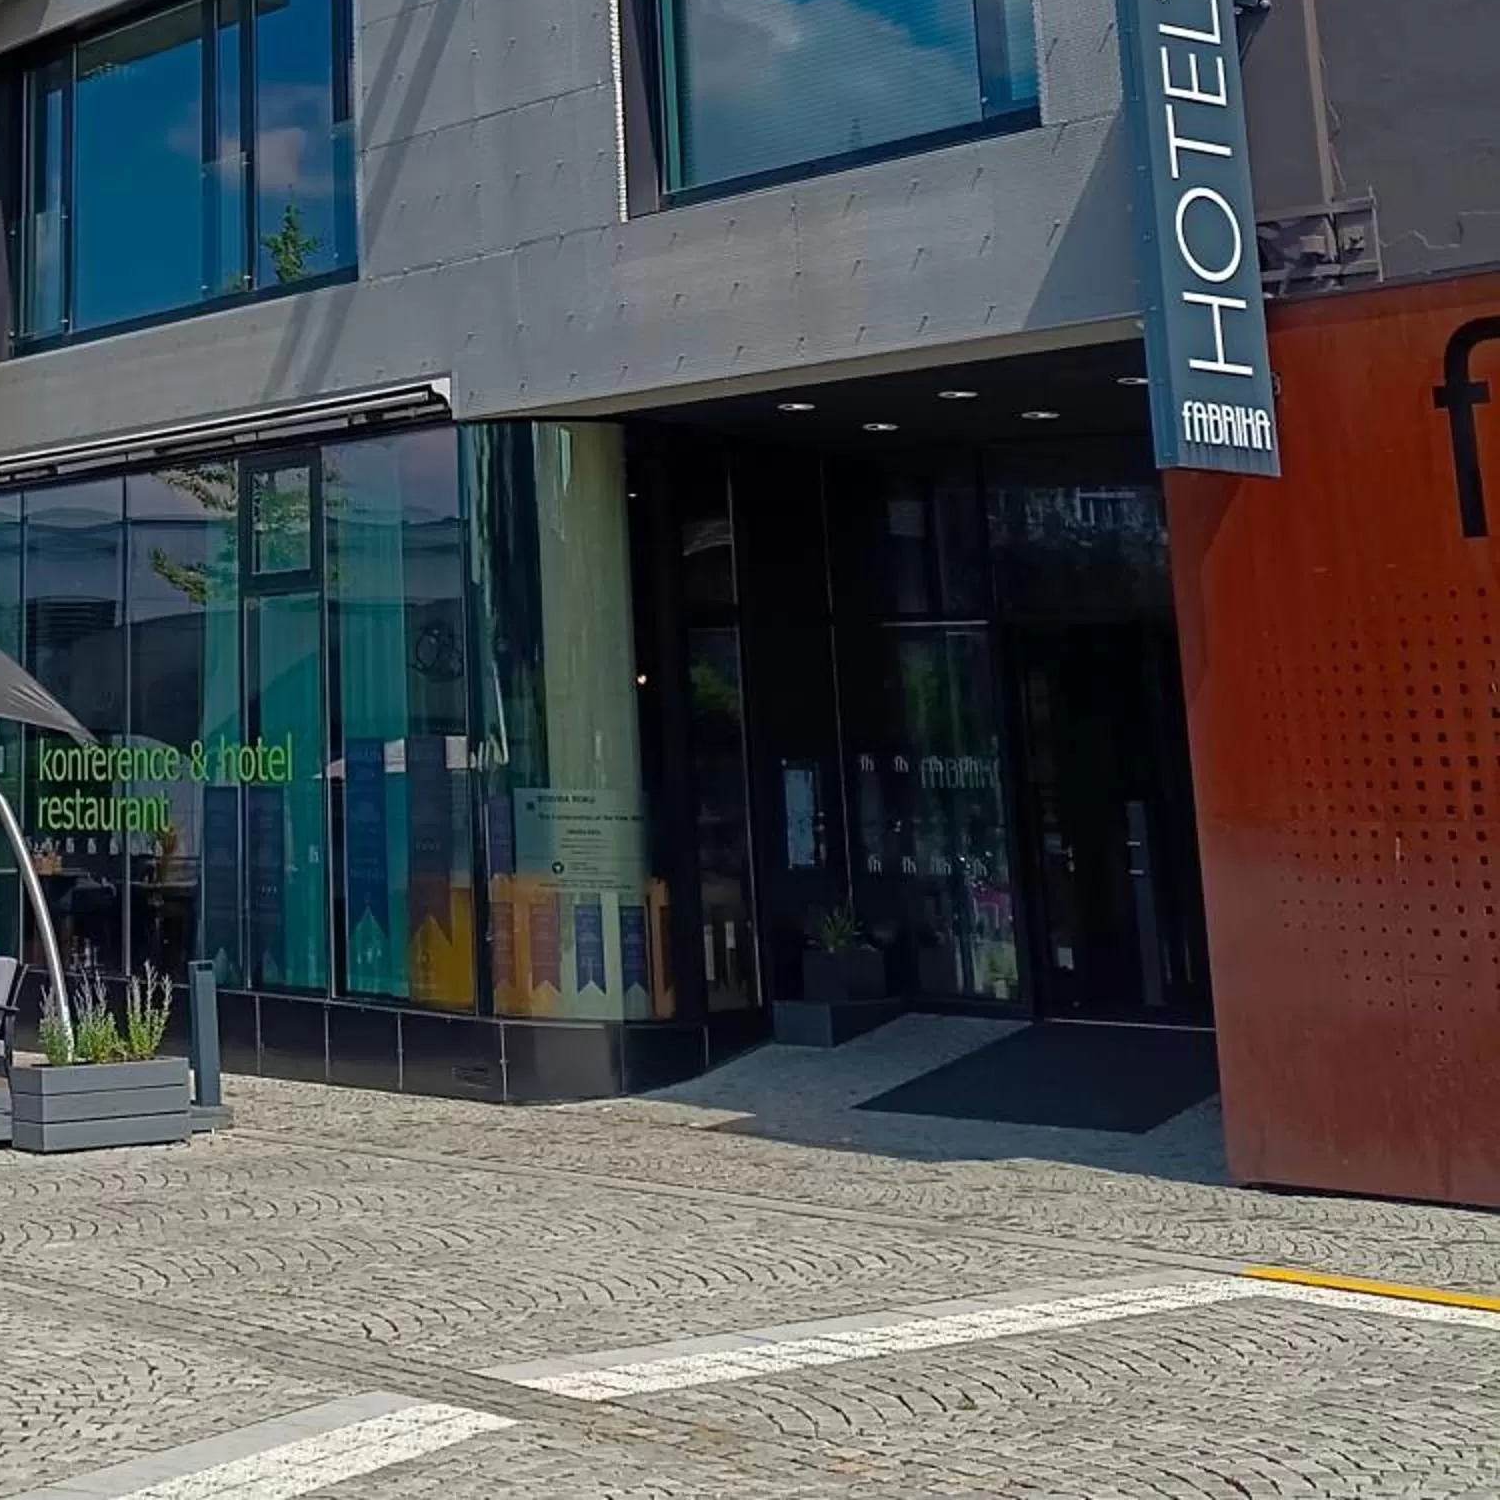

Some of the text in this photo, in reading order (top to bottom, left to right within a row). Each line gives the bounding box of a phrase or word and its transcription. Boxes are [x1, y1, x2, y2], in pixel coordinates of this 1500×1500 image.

[38, 732, 293, 782] konference & hotel
[38, 789, 172, 832] restaurant
